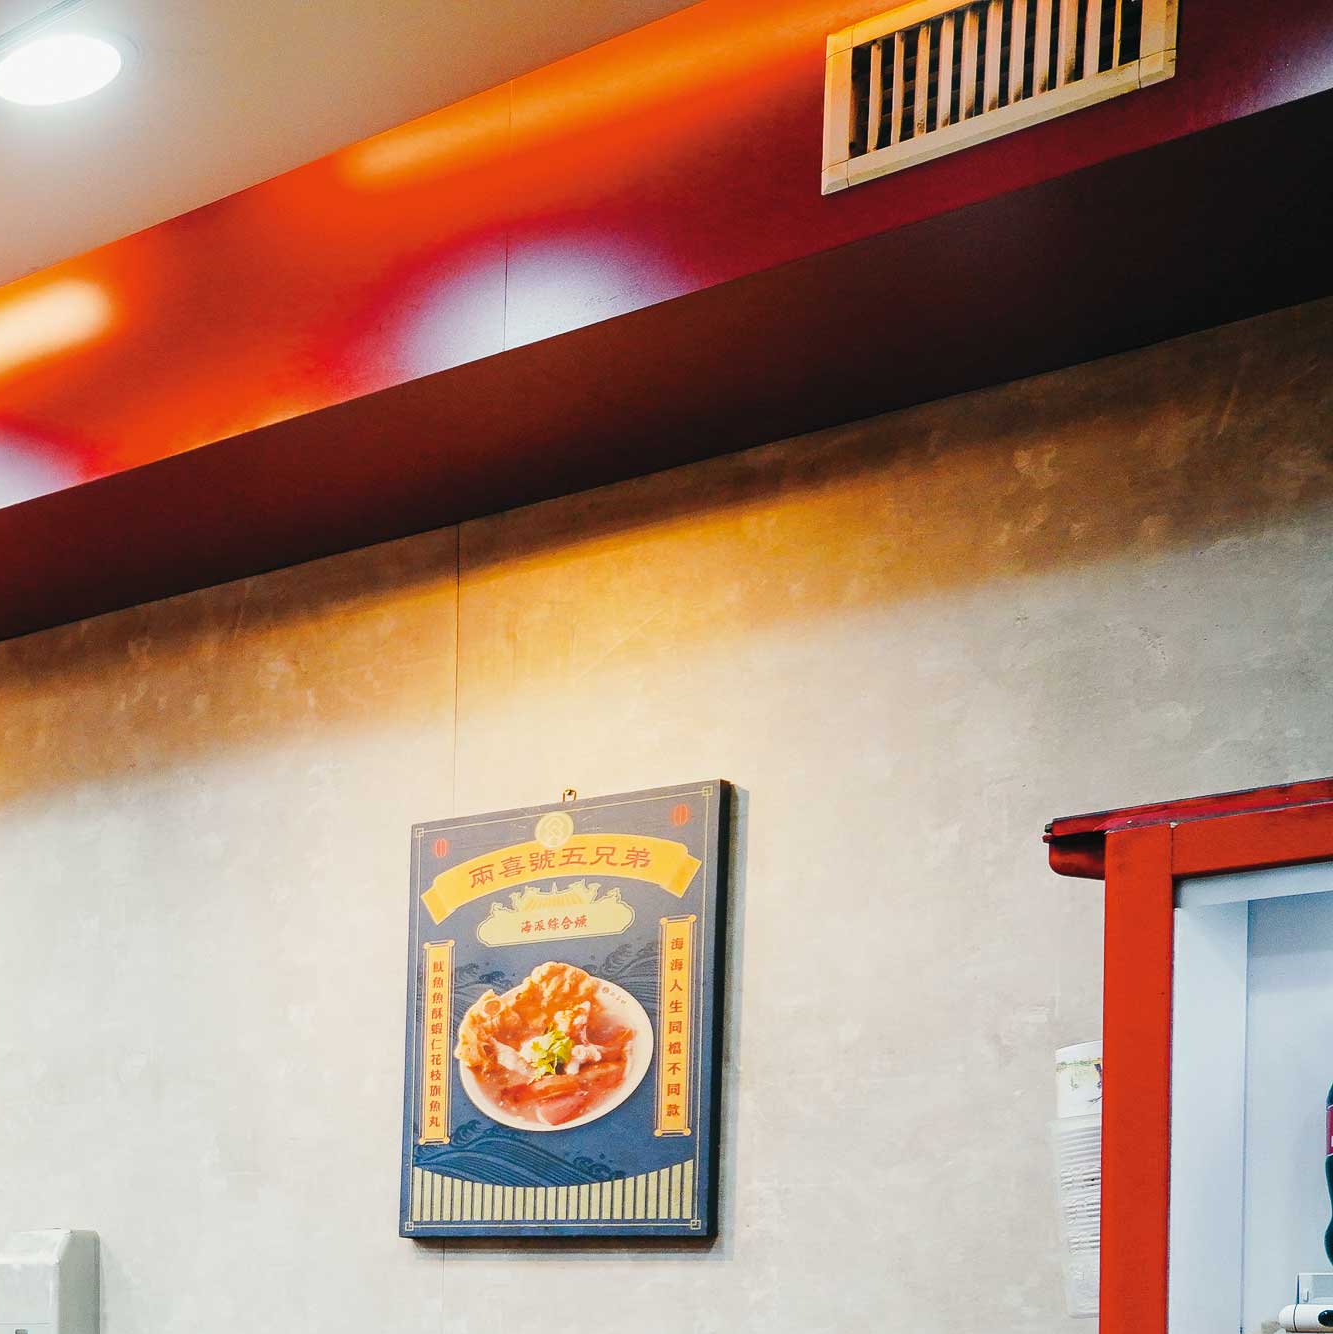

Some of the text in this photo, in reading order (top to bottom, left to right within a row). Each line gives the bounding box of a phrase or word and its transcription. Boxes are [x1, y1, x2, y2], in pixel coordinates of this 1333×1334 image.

[469, 846, 652, 889] 兩喜號五兄弟
